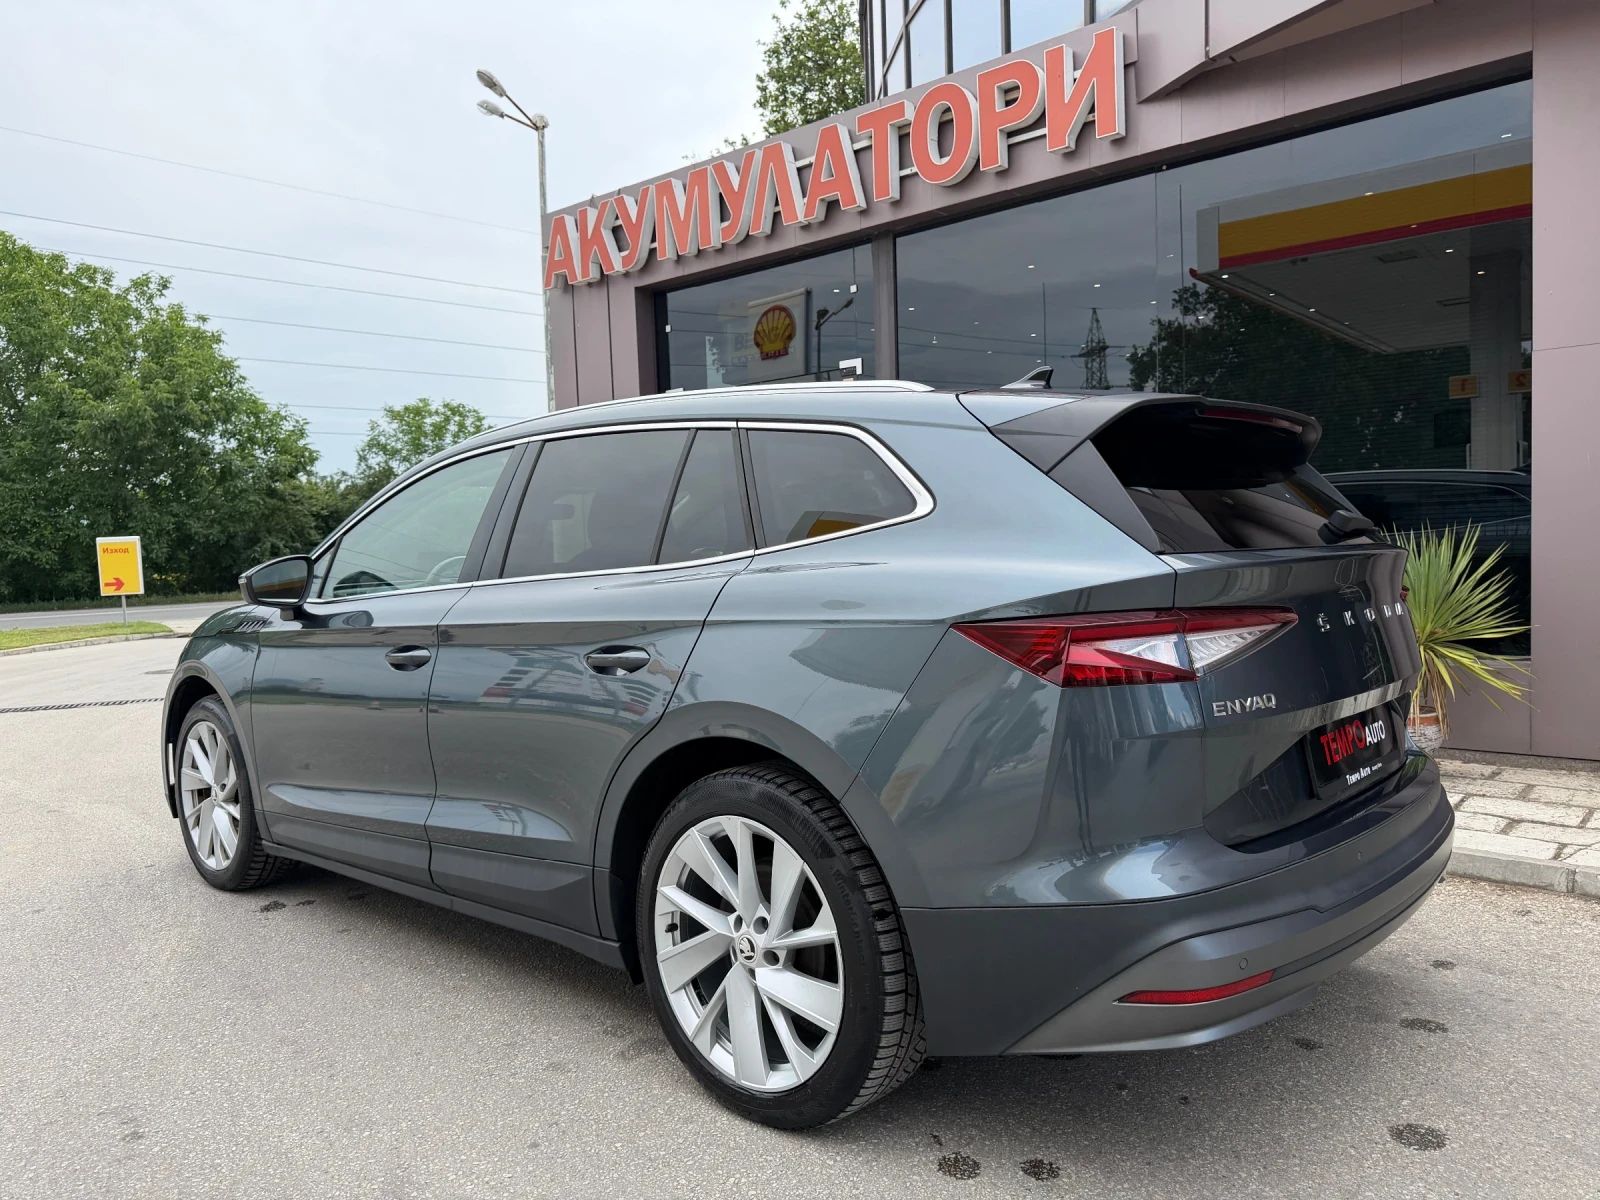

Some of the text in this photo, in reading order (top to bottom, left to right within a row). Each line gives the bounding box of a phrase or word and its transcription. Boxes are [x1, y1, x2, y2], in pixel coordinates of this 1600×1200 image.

[543, 26, 1125, 290] АКУМУЛАТОРИ
[1212, 693, 1277, 717] ENYAQ
[1320, 720, 1386, 767] TEMPO AUTO
